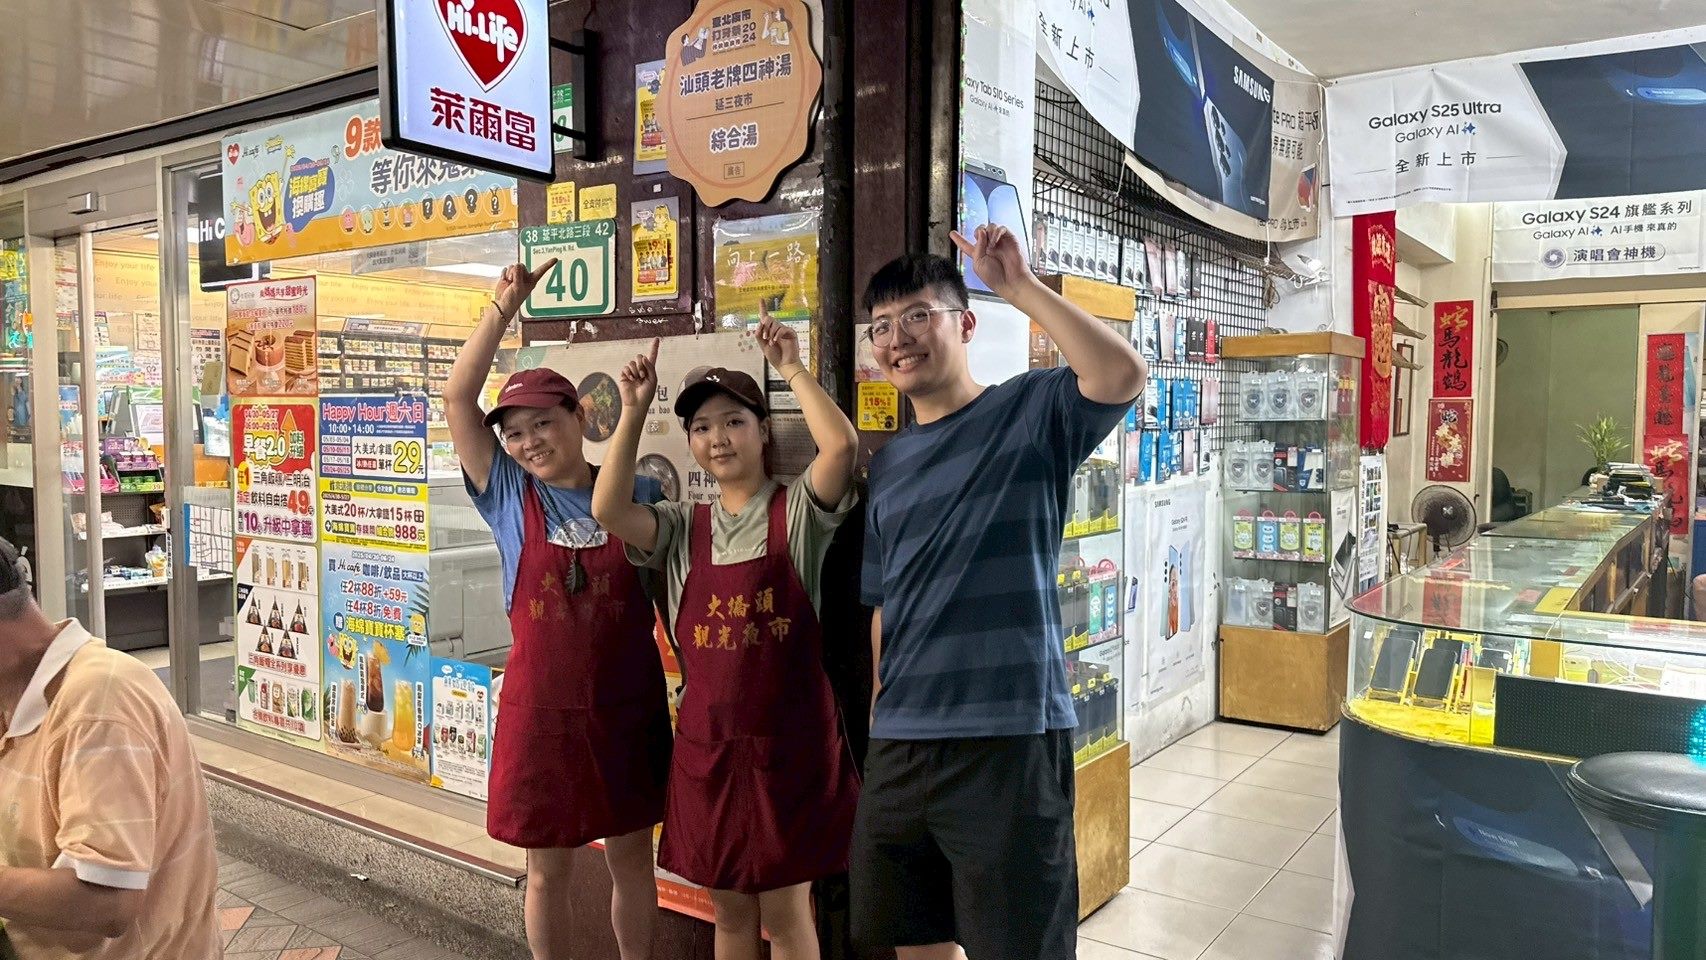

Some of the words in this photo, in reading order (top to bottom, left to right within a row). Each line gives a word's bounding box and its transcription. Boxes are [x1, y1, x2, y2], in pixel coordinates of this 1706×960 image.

[743, 22, 756, 32] 20
[743, 32, 756, 43] 24
[679, 53, 793, 96] 汕頭老牌四神湯
[1233, 65, 1271, 103] SAMSUNG
[715, 93, 753, 112] 延三夜市
[980, 80, 993, 97] Tab
[992, 87, 1003, 101] S10
[1003, 91, 1025, 110] Series
[430, 87, 536, 152] 萊爾富
[1368, 108, 1429, 130] Galaxy
[1430, 104, 1460, 118] S25
[1462, 101, 1502, 116] Ultra
[711, 124, 758, 151] 綜合湯
[1395, 125, 1443, 143] Galaxy
[1446, 125, 1459, 136] AI
[371, 154, 479, 194] 等你來
[1395, 151, 1478, 174] 全新上市
[1522, 209, 1587, 226] Galaxy
[1589, 205, 1620, 219] S24
[1624, 200, 1692, 218] 旗艦系列
[200, 220, 213, 242] Hi
[525, 230, 539, 244] 38
[542, 226, 592, 242] 延平北路三段
[594, 222, 610, 236] 42
[1533, 228, 1576, 240] Galaxy
[1577, 226, 1589, 236] AI
[1610, 224, 1644, 235] AI手機
[1646, 222, 1678, 232] 來真的
[1573, 245, 1656, 262] 演唱會神機
[545, 257, 589, 302] 40
[322, 402, 357, 423] Happy
[357, 402, 386, 422] Hour
[386, 401, 425, 424] 週六日
[328, 423, 348, 434] 10:00
[352, 424, 375, 434] 14:00
[688, 491, 704, 500] Four
[1154, 499, 1171, 508] SAMSUNG
[383, 606, 402, 621] 免費
[706, 587, 775, 620] 大橋頭
[692, 616, 792, 651] 觀光夜市
